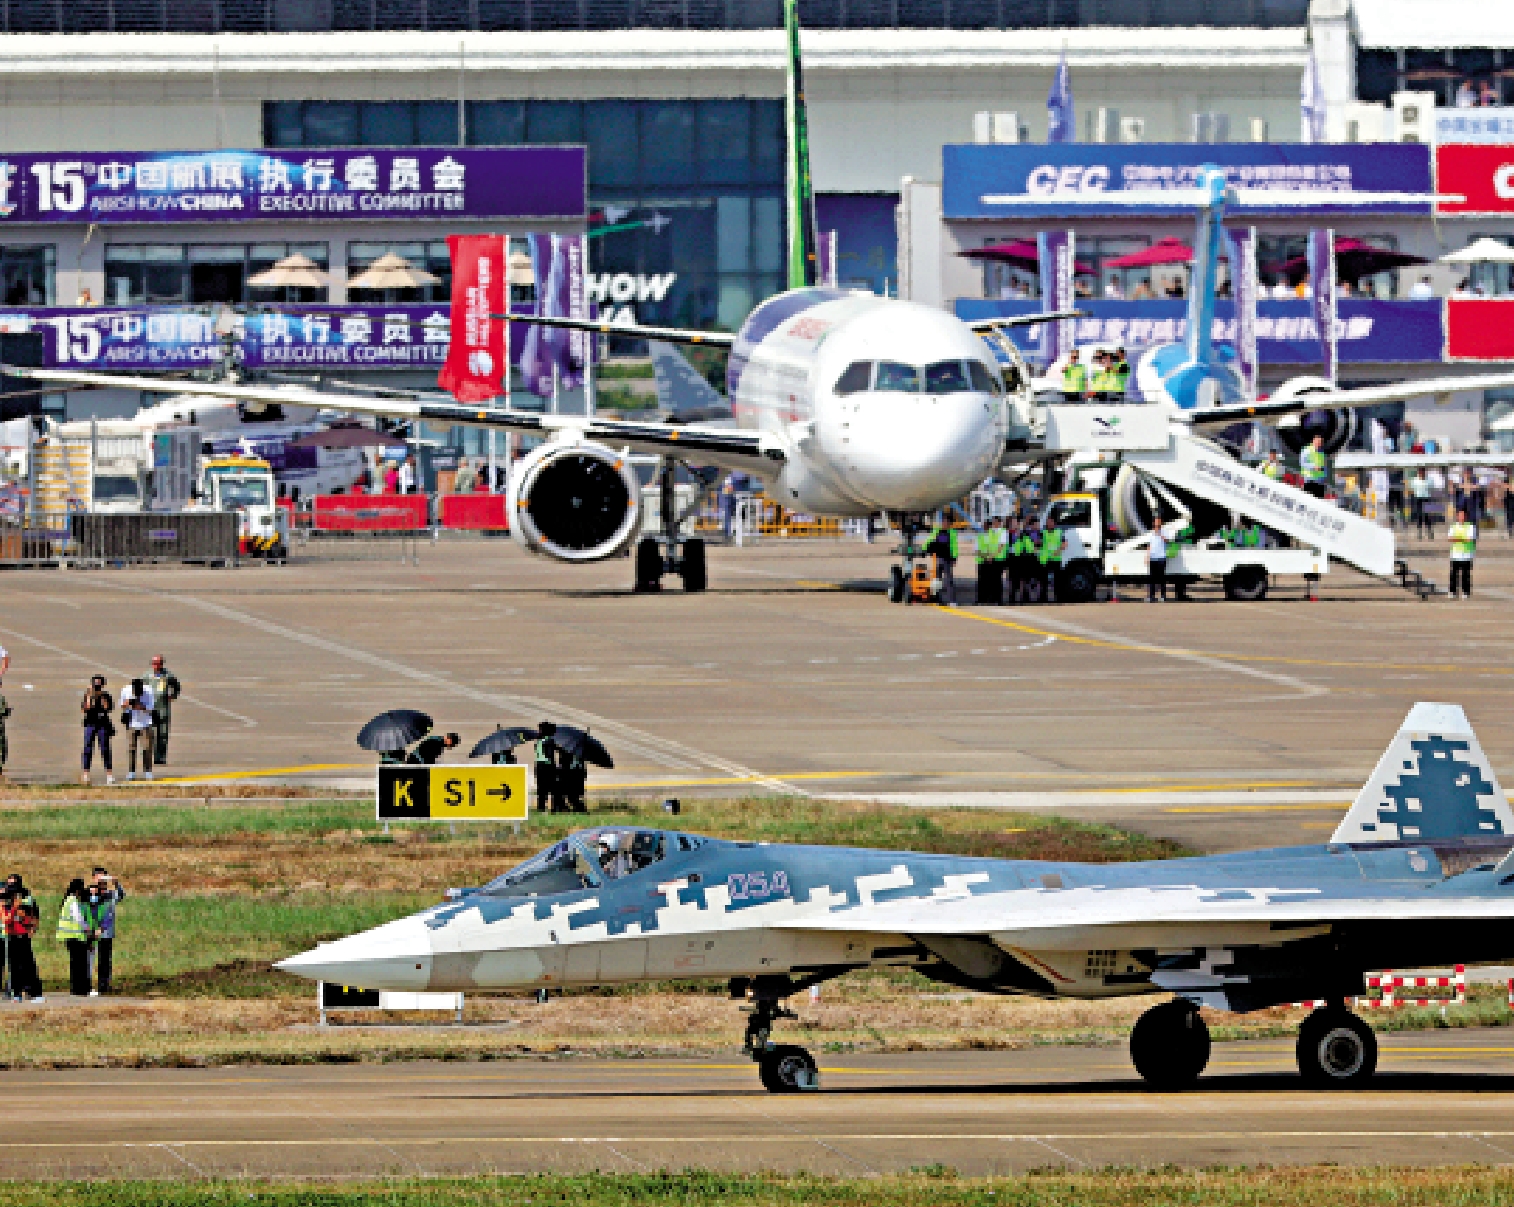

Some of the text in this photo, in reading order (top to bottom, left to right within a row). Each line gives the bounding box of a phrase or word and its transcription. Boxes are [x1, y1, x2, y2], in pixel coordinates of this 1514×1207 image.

[258, 155, 467, 192] 执行委员会
[1026, 164, 1110, 195] CEC
[353, 346, 449, 363] COMMITTE
[392, 777, 476, 807] K S1
